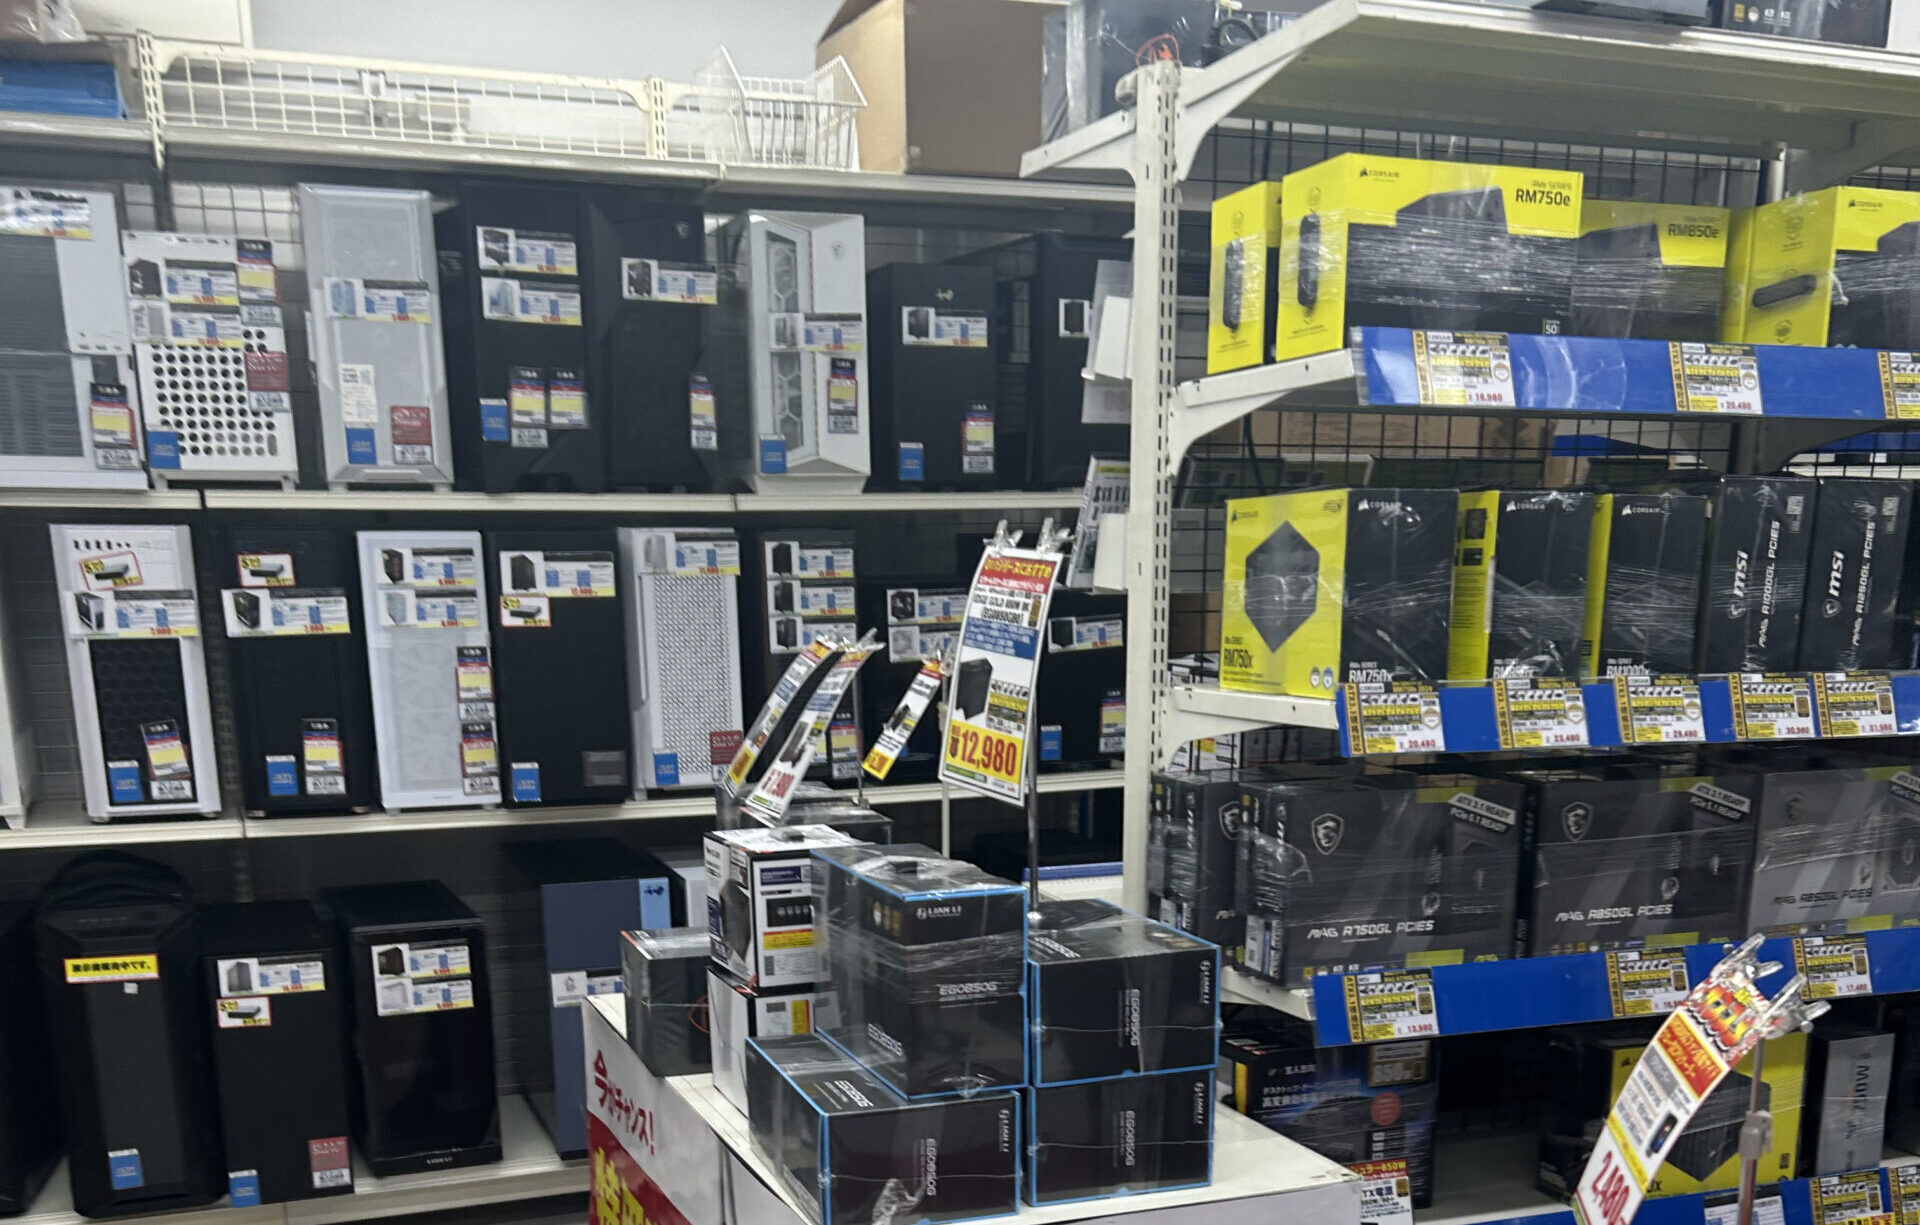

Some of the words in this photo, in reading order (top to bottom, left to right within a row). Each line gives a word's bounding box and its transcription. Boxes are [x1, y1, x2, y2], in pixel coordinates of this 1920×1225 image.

[1515, 189, 1571, 208] RM750e
[1667, 222, 1719, 239] RM850e
[1767, 520, 1780, 558] PCIE5
[1863, 521, 1876, 558] PCIE5
[1733, 551, 1749, 597] msi
[1762, 561, 1776, 615] A1000GL
[1829, 551, 1845, 597] msi
[1349, 670, 1394, 683] RM750x
[962, 730, 1018, 777] 12,980
[1306, 927, 1339, 940] MAG
[1342, 923, 1392, 937] A750GL
[1396, 920, 1435, 932] PCIE5
[1587, 907, 1634, 921] A850GL
[1636, 904, 1673, 916] PCIE5
